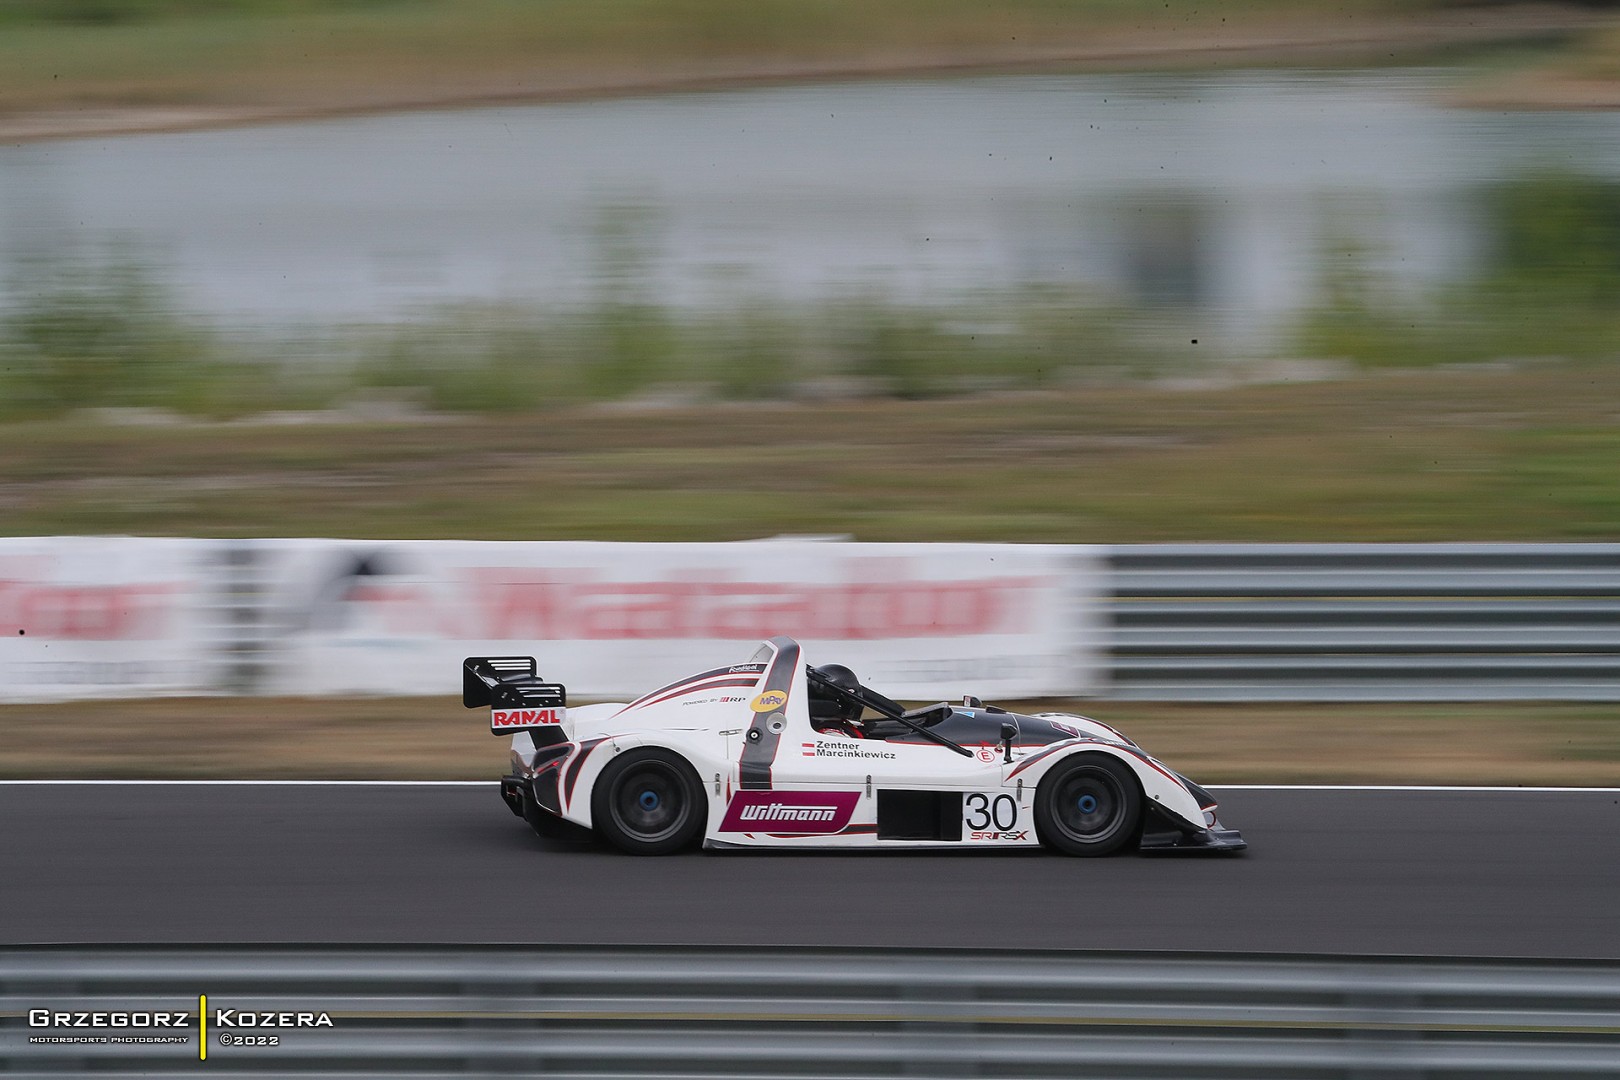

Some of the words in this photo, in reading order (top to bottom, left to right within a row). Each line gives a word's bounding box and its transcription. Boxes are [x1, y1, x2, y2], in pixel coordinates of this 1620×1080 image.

[494, 710, 561, 726] RANAL
[816, 741, 860, 751] Zentner
[816, 749, 897, 760] Marcinkiewicz
[965, 793, 1018, 832] 30
